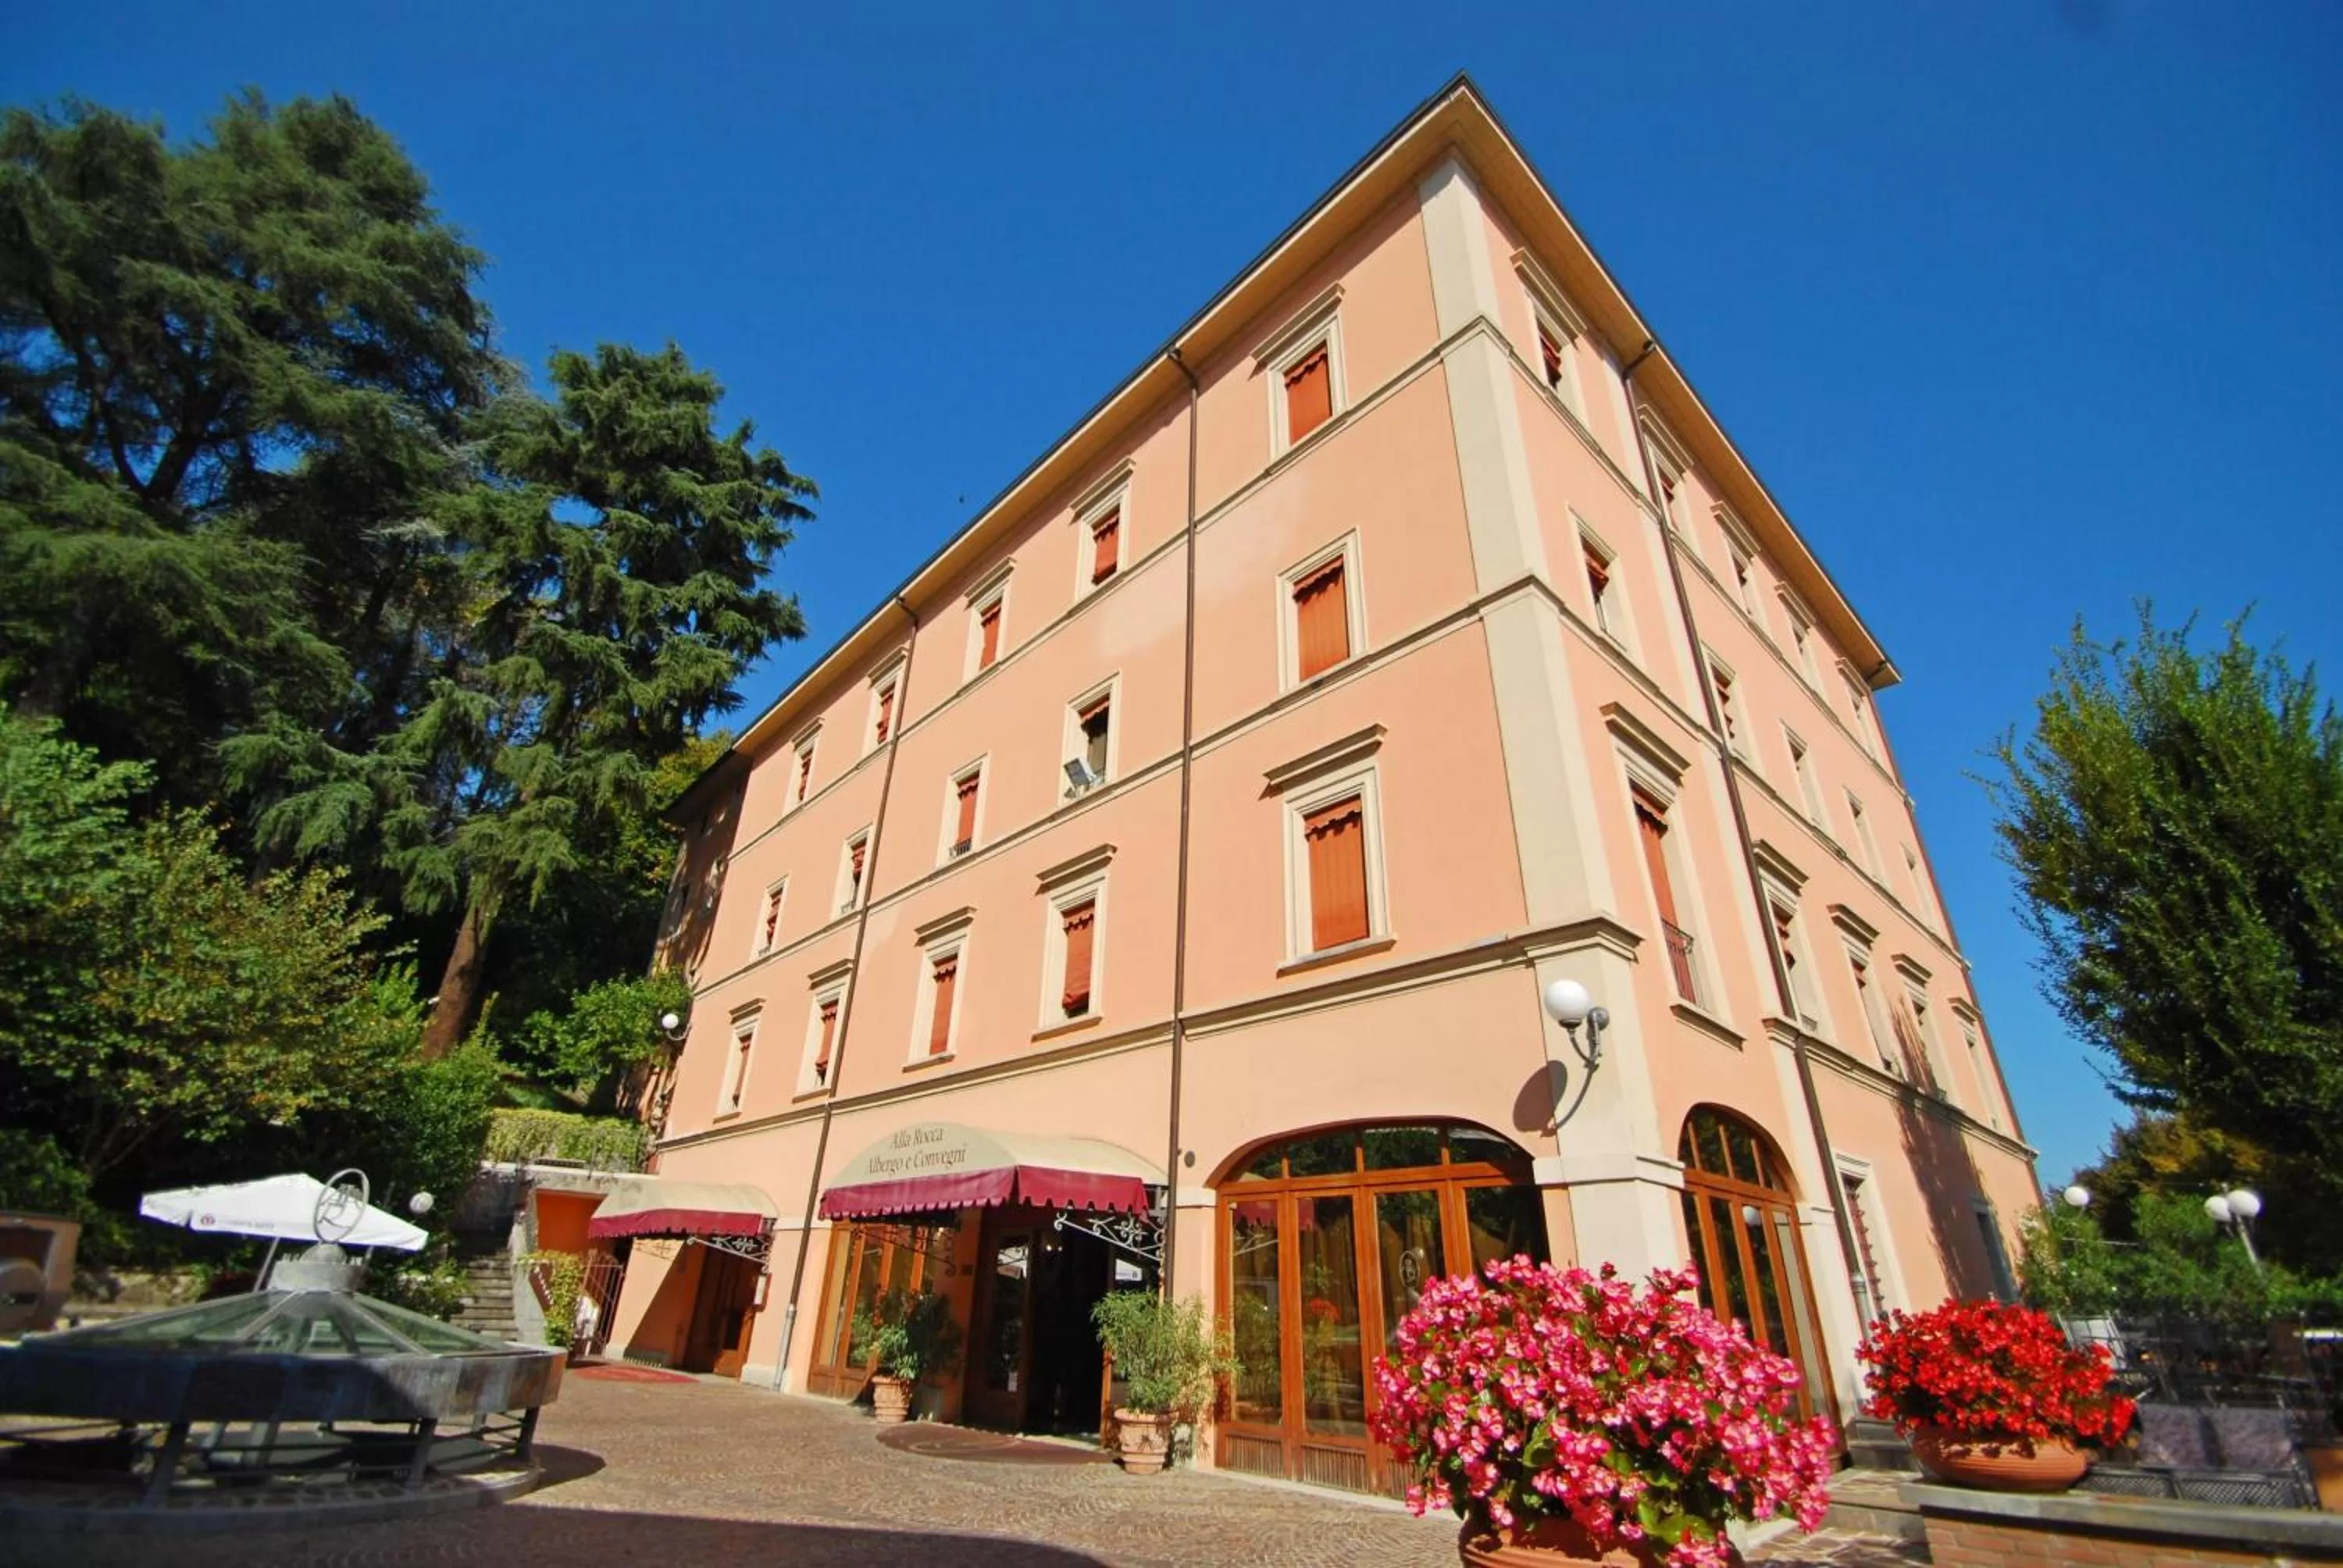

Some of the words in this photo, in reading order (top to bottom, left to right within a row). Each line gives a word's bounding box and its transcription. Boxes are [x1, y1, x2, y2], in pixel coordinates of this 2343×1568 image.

[890, 1129, 911, 1150] Alla
[912, 1127, 943, 1147] Rocca
[865, 1155, 904, 1177] Albergo
[905, 1155, 912, 1171] e
[913, 1143, 967, 1170] Convegni
